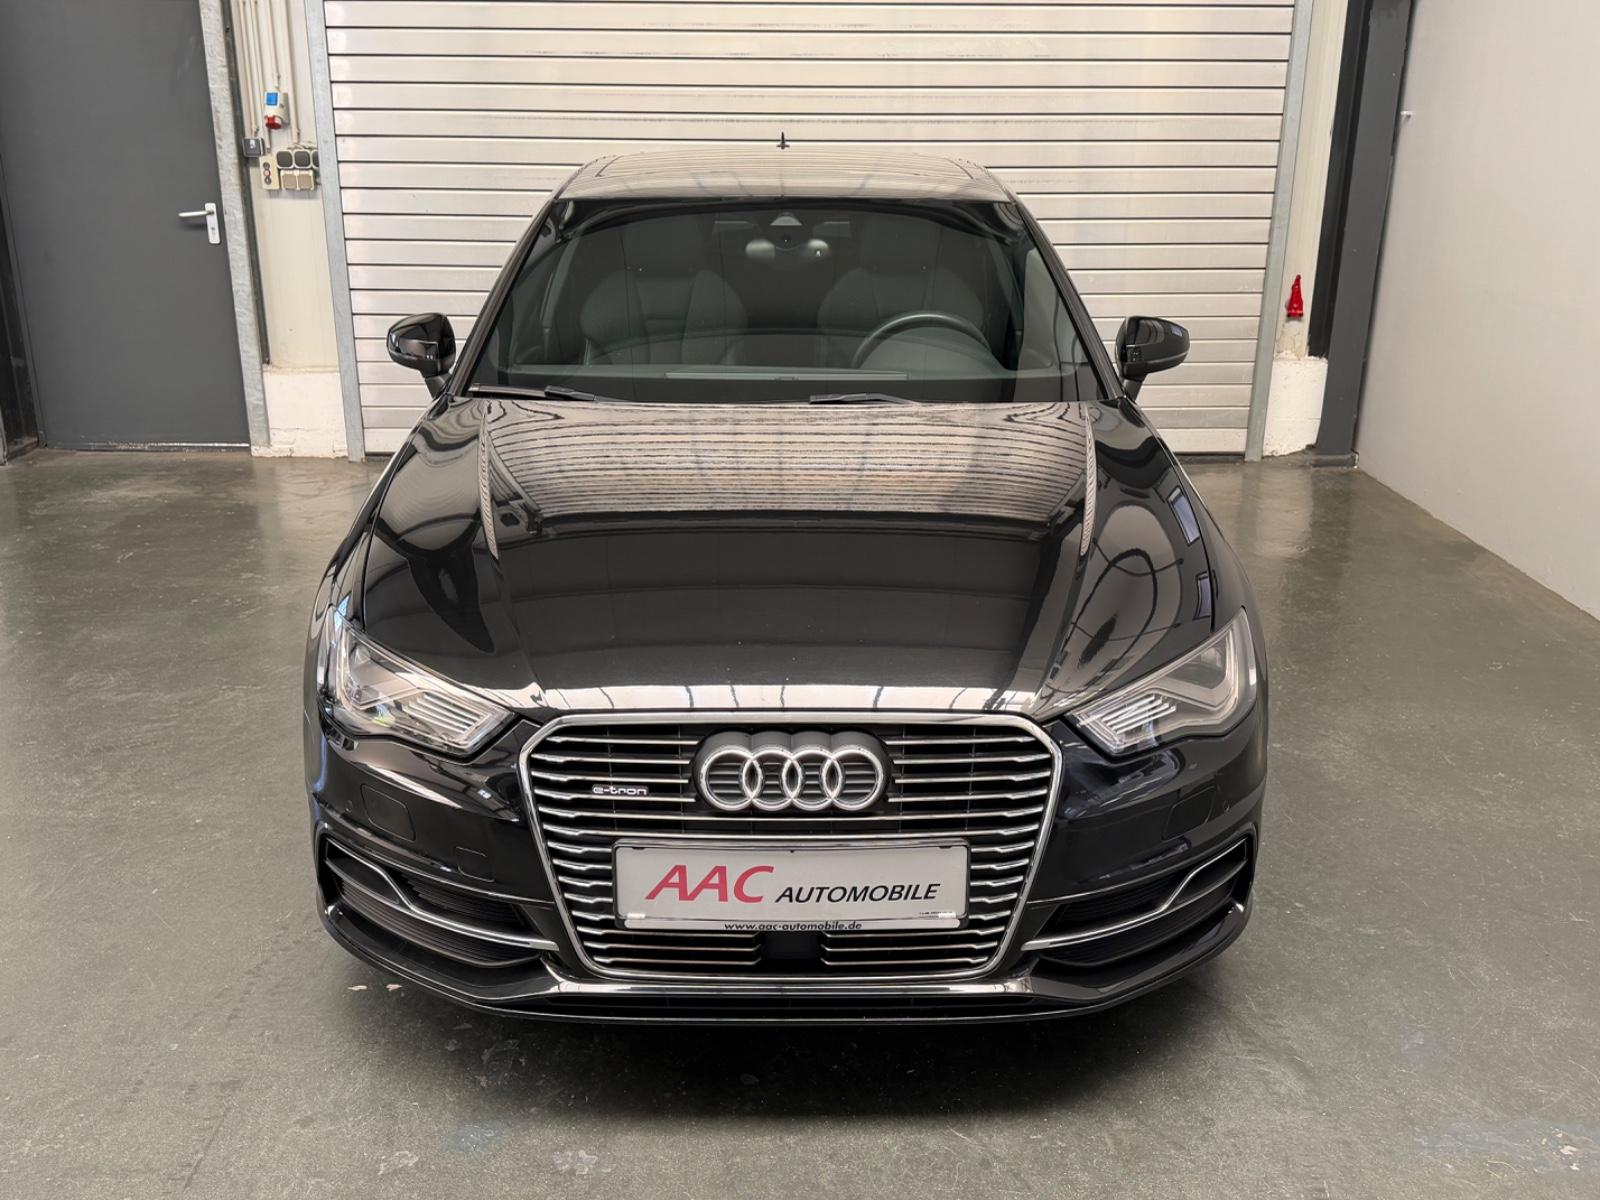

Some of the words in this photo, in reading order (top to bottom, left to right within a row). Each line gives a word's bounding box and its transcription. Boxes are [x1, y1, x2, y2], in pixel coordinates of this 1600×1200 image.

[593, 785, 648, 796] e-tron
[644, 864, 774, 903] AAC
[775, 883, 941, 903] AUTOMOBILE
[724, 921, 862, 931] www.aac-automobile.de
